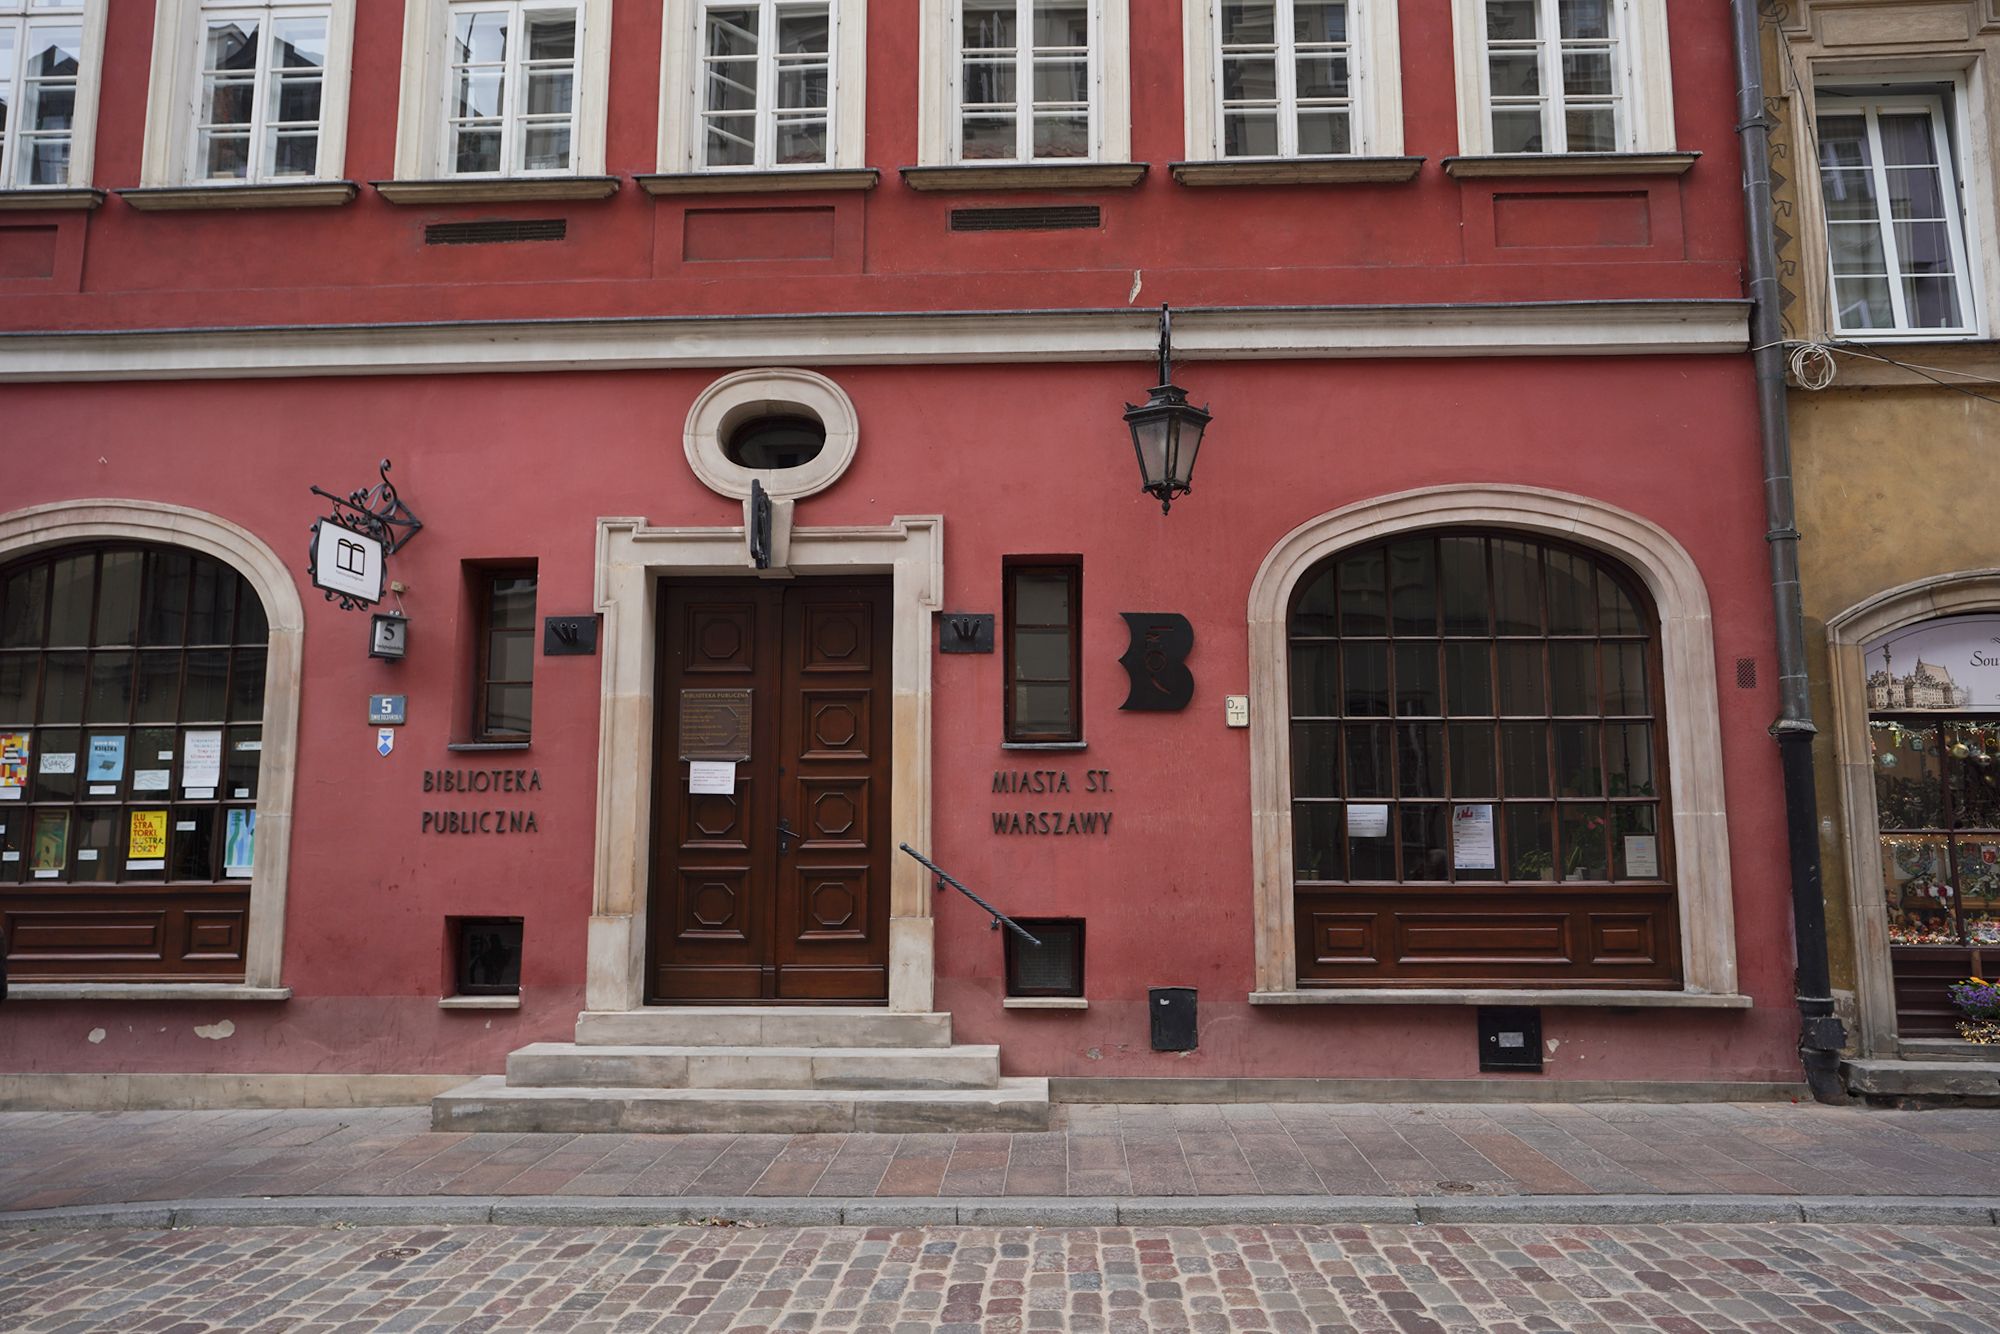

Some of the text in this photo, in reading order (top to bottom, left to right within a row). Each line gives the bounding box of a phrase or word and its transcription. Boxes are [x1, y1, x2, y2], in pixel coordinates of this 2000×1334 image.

[384, 622, 395, 641] 5
[381, 698, 393, 714] 5
[423, 769, 542, 792] BIBLIOTEKA
[991, 769, 1113, 793] MIASTA ST.
[133, 821, 153, 829] STRA
[422, 810, 538, 834] PUBLICZNA
[991, 811, 1113, 835] WARSZAWY
